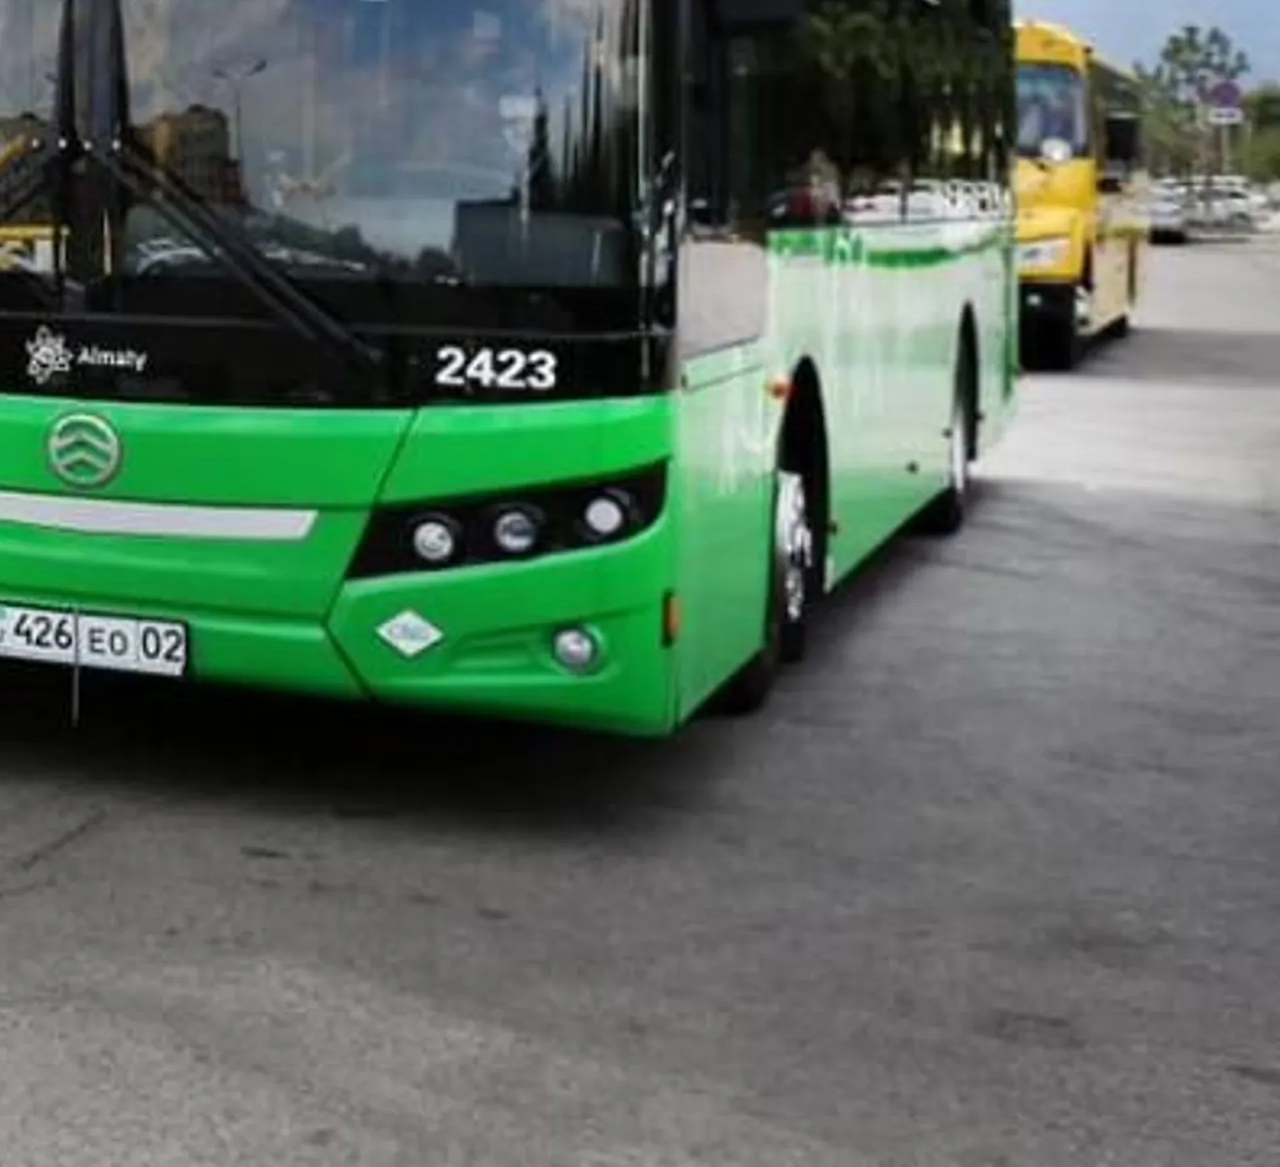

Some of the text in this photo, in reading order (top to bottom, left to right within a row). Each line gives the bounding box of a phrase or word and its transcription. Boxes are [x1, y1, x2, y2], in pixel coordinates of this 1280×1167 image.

[76, 345, 148, 372] Almaty
[435, 344, 558, 390] 2423
[13, 613, 74, 650] 426
[89, 627, 130, 657] EO
[141, 626, 184, 664] 02
